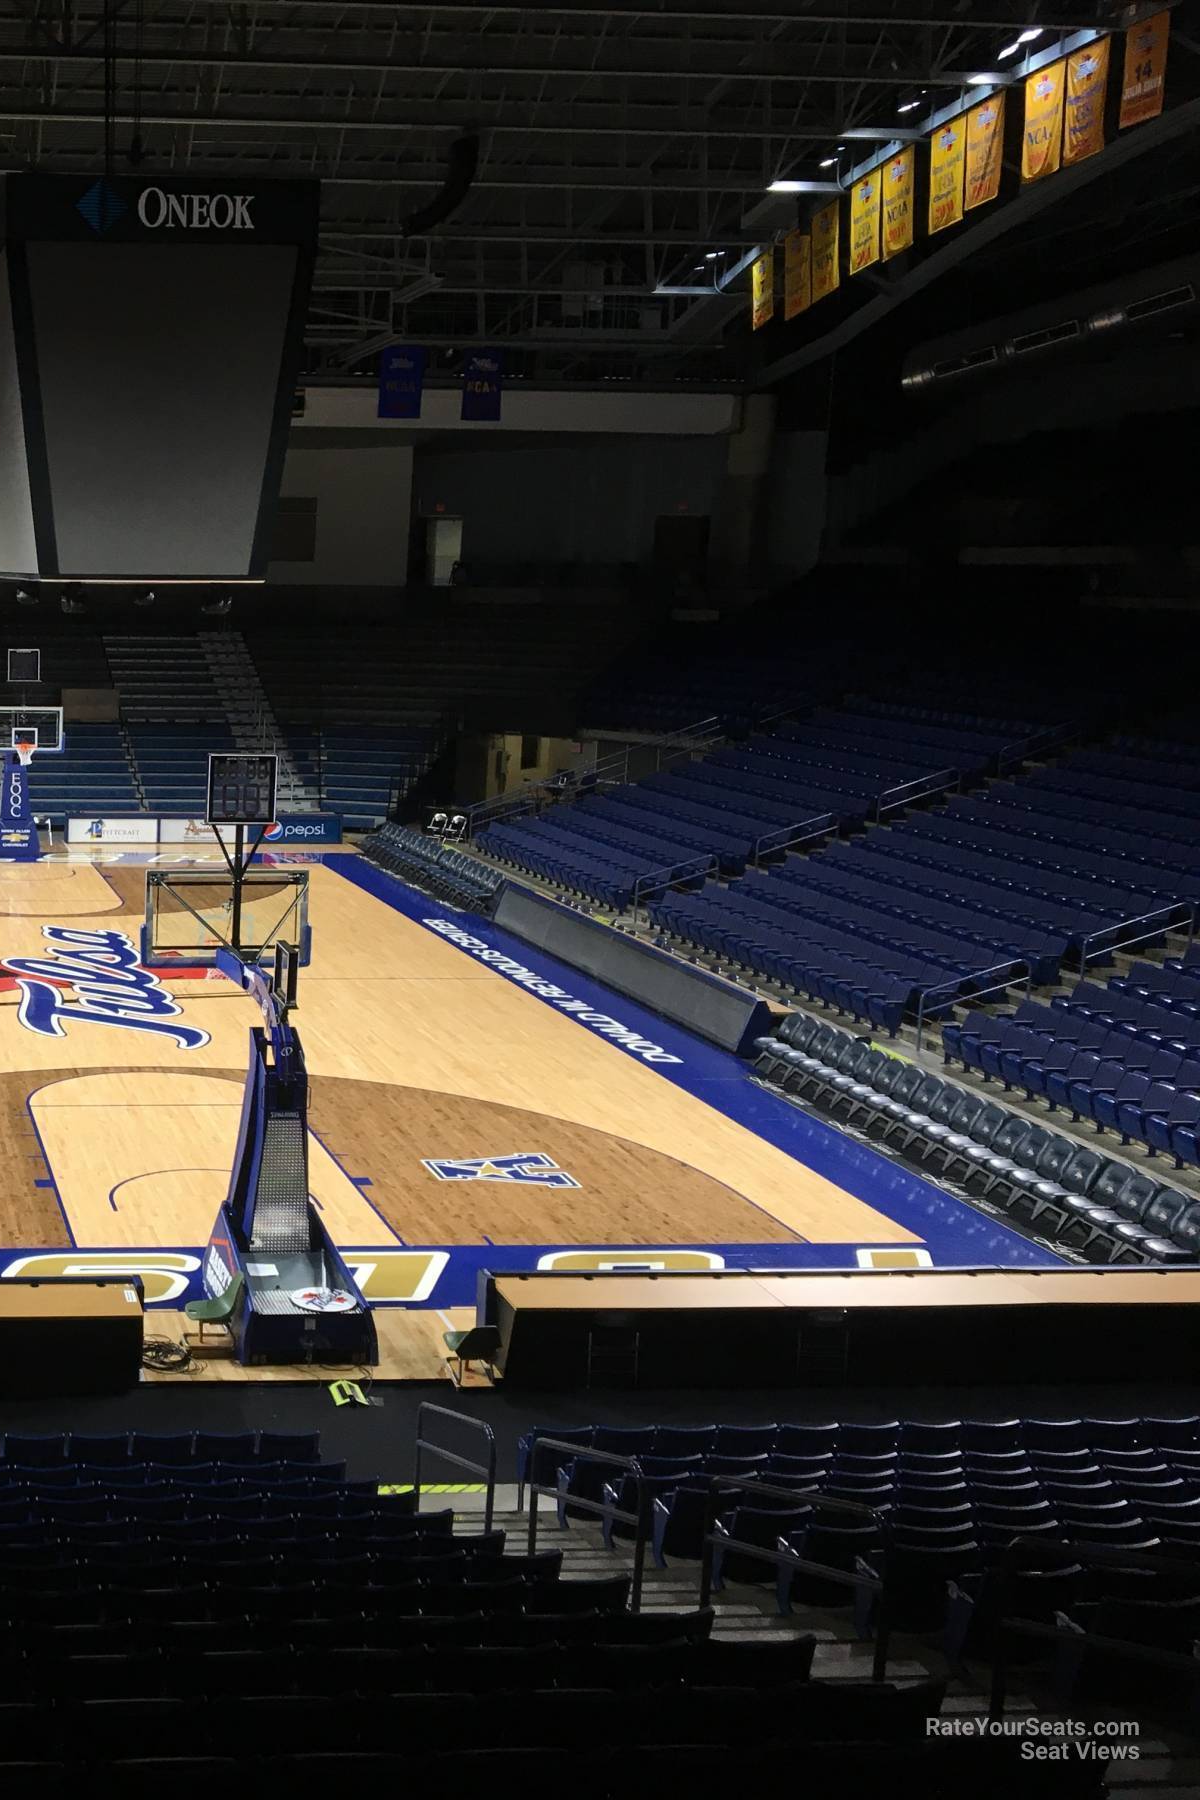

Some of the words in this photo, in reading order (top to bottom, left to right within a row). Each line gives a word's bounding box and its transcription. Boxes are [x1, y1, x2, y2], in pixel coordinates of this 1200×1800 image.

[137, 186, 256, 230] ONEOK
[285, 823, 326, 838] pepsi
[422, 918, 488, 949] CENTER
[0, 925, 211, 1050] Tulsa
[473, 948, 574, 1002] REYNOLDS
[558, 1001, 596, 1013] W.
[577, 1011, 685, 1064] DONALD
